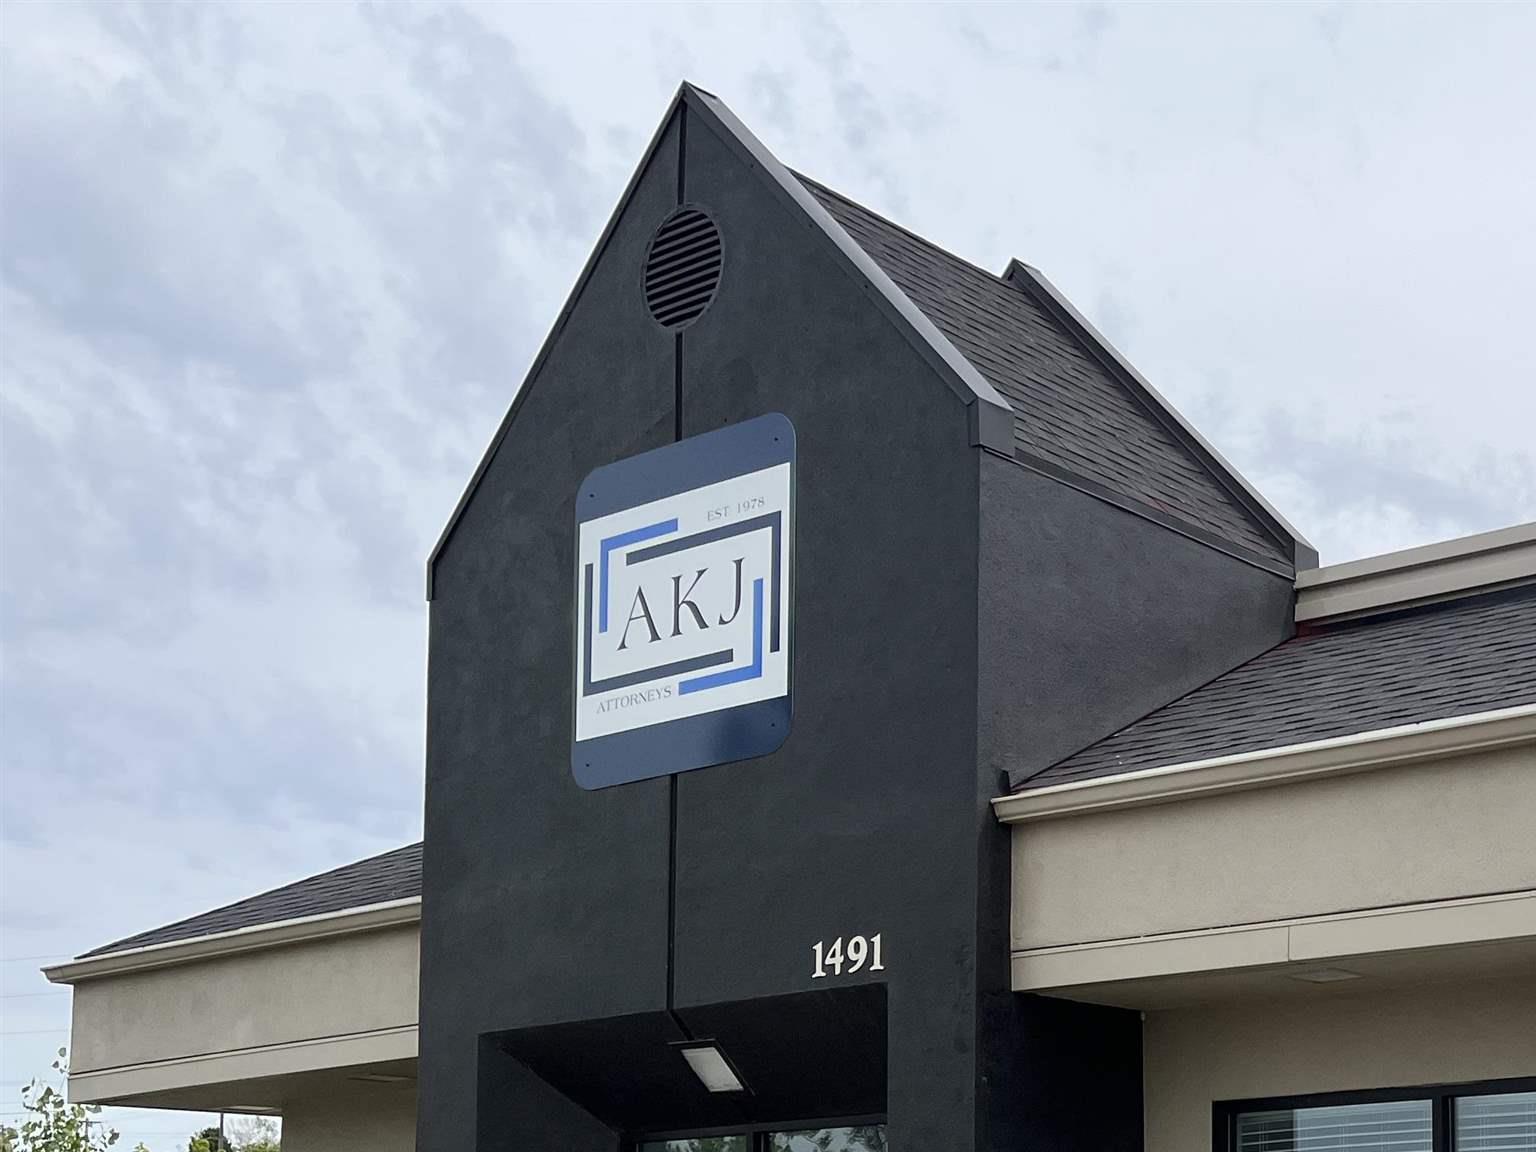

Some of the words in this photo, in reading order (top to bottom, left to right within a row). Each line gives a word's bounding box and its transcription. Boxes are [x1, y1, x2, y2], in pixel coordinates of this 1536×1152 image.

[707, 504, 729, 521] EST
[736, 496, 765, 513] 1978
[616, 557, 745, 651] AKJ
[596, 685, 672, 713] ATTORNEYS
[811, 933, 885, 978] 1491
